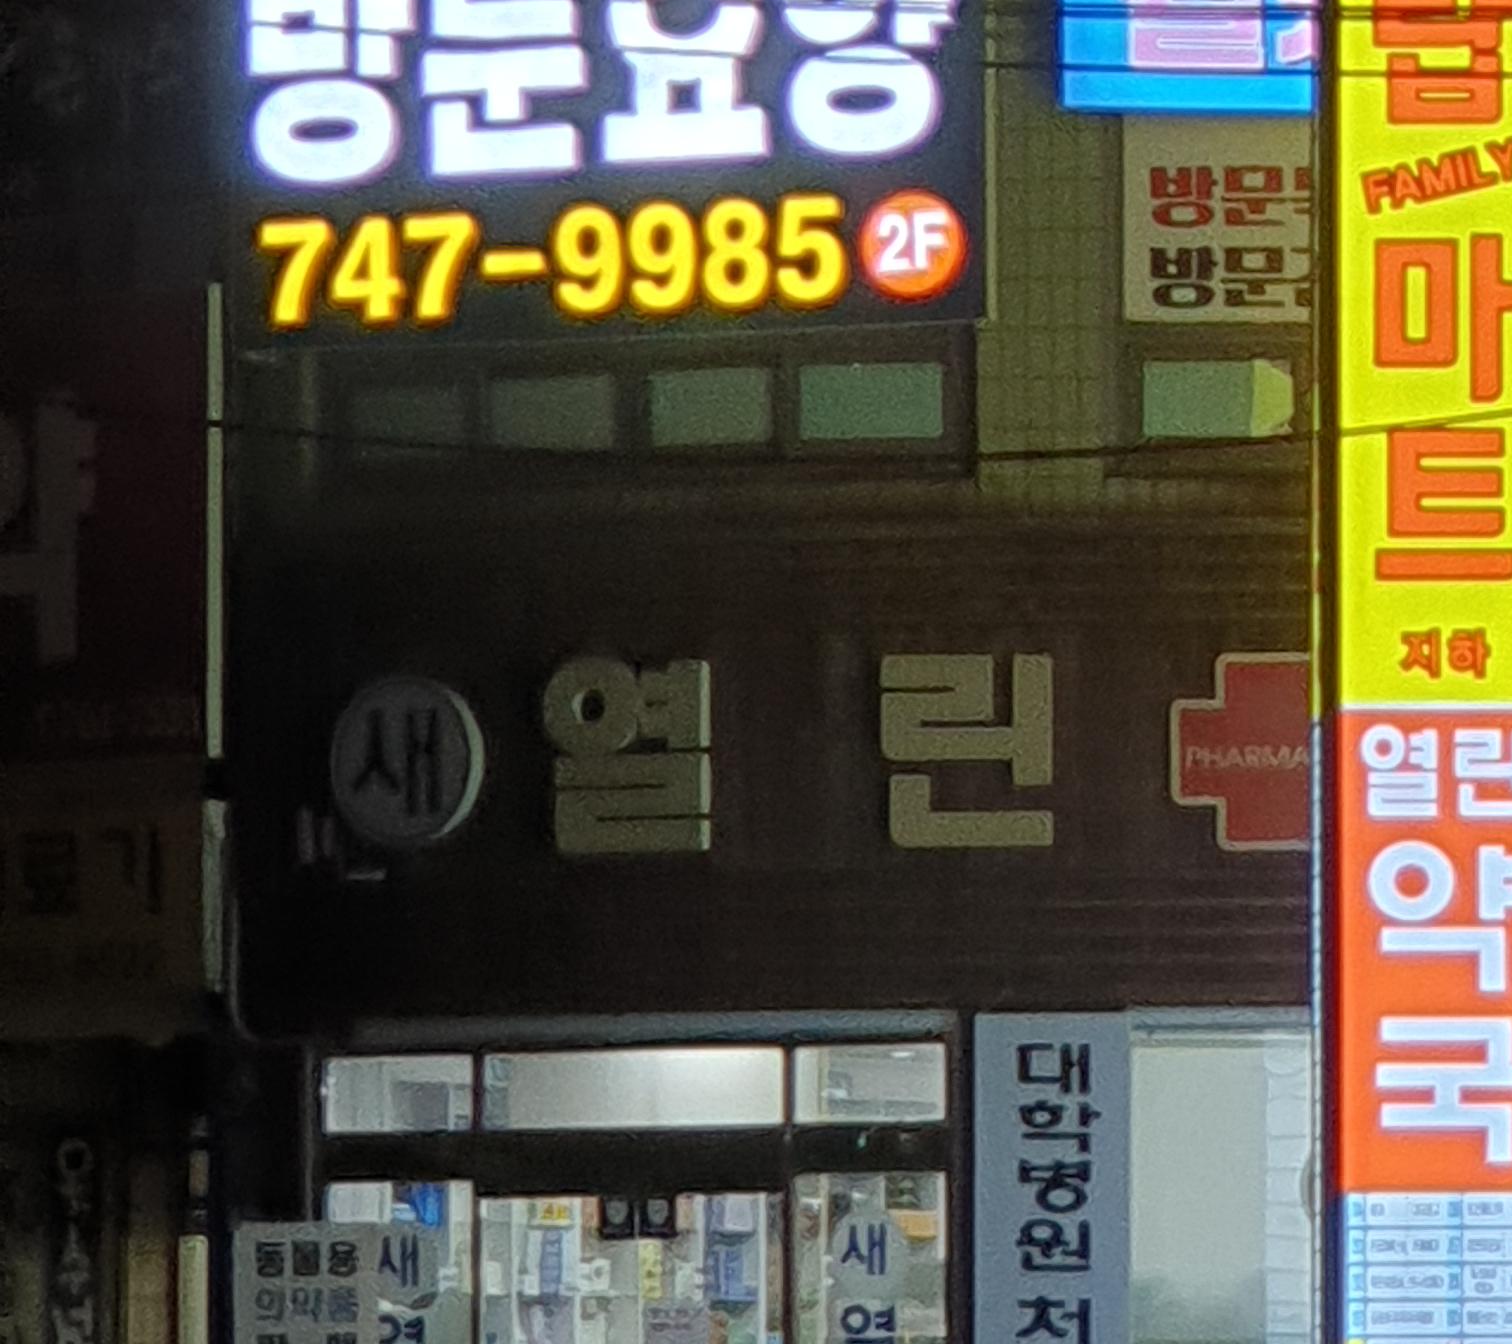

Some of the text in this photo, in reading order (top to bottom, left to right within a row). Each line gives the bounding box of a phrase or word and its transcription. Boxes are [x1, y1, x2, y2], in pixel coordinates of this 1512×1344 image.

[256, 193, 952, 328] 747-9985 2F
[1398, 626, 1491, 679] 지하
[350, 706, 442, 818] 새
[1014, 1040, 1103, 1274] 대학병원
[378, 1235, 420, 1288] 새
[841, 1223, 887, 1275] 새
